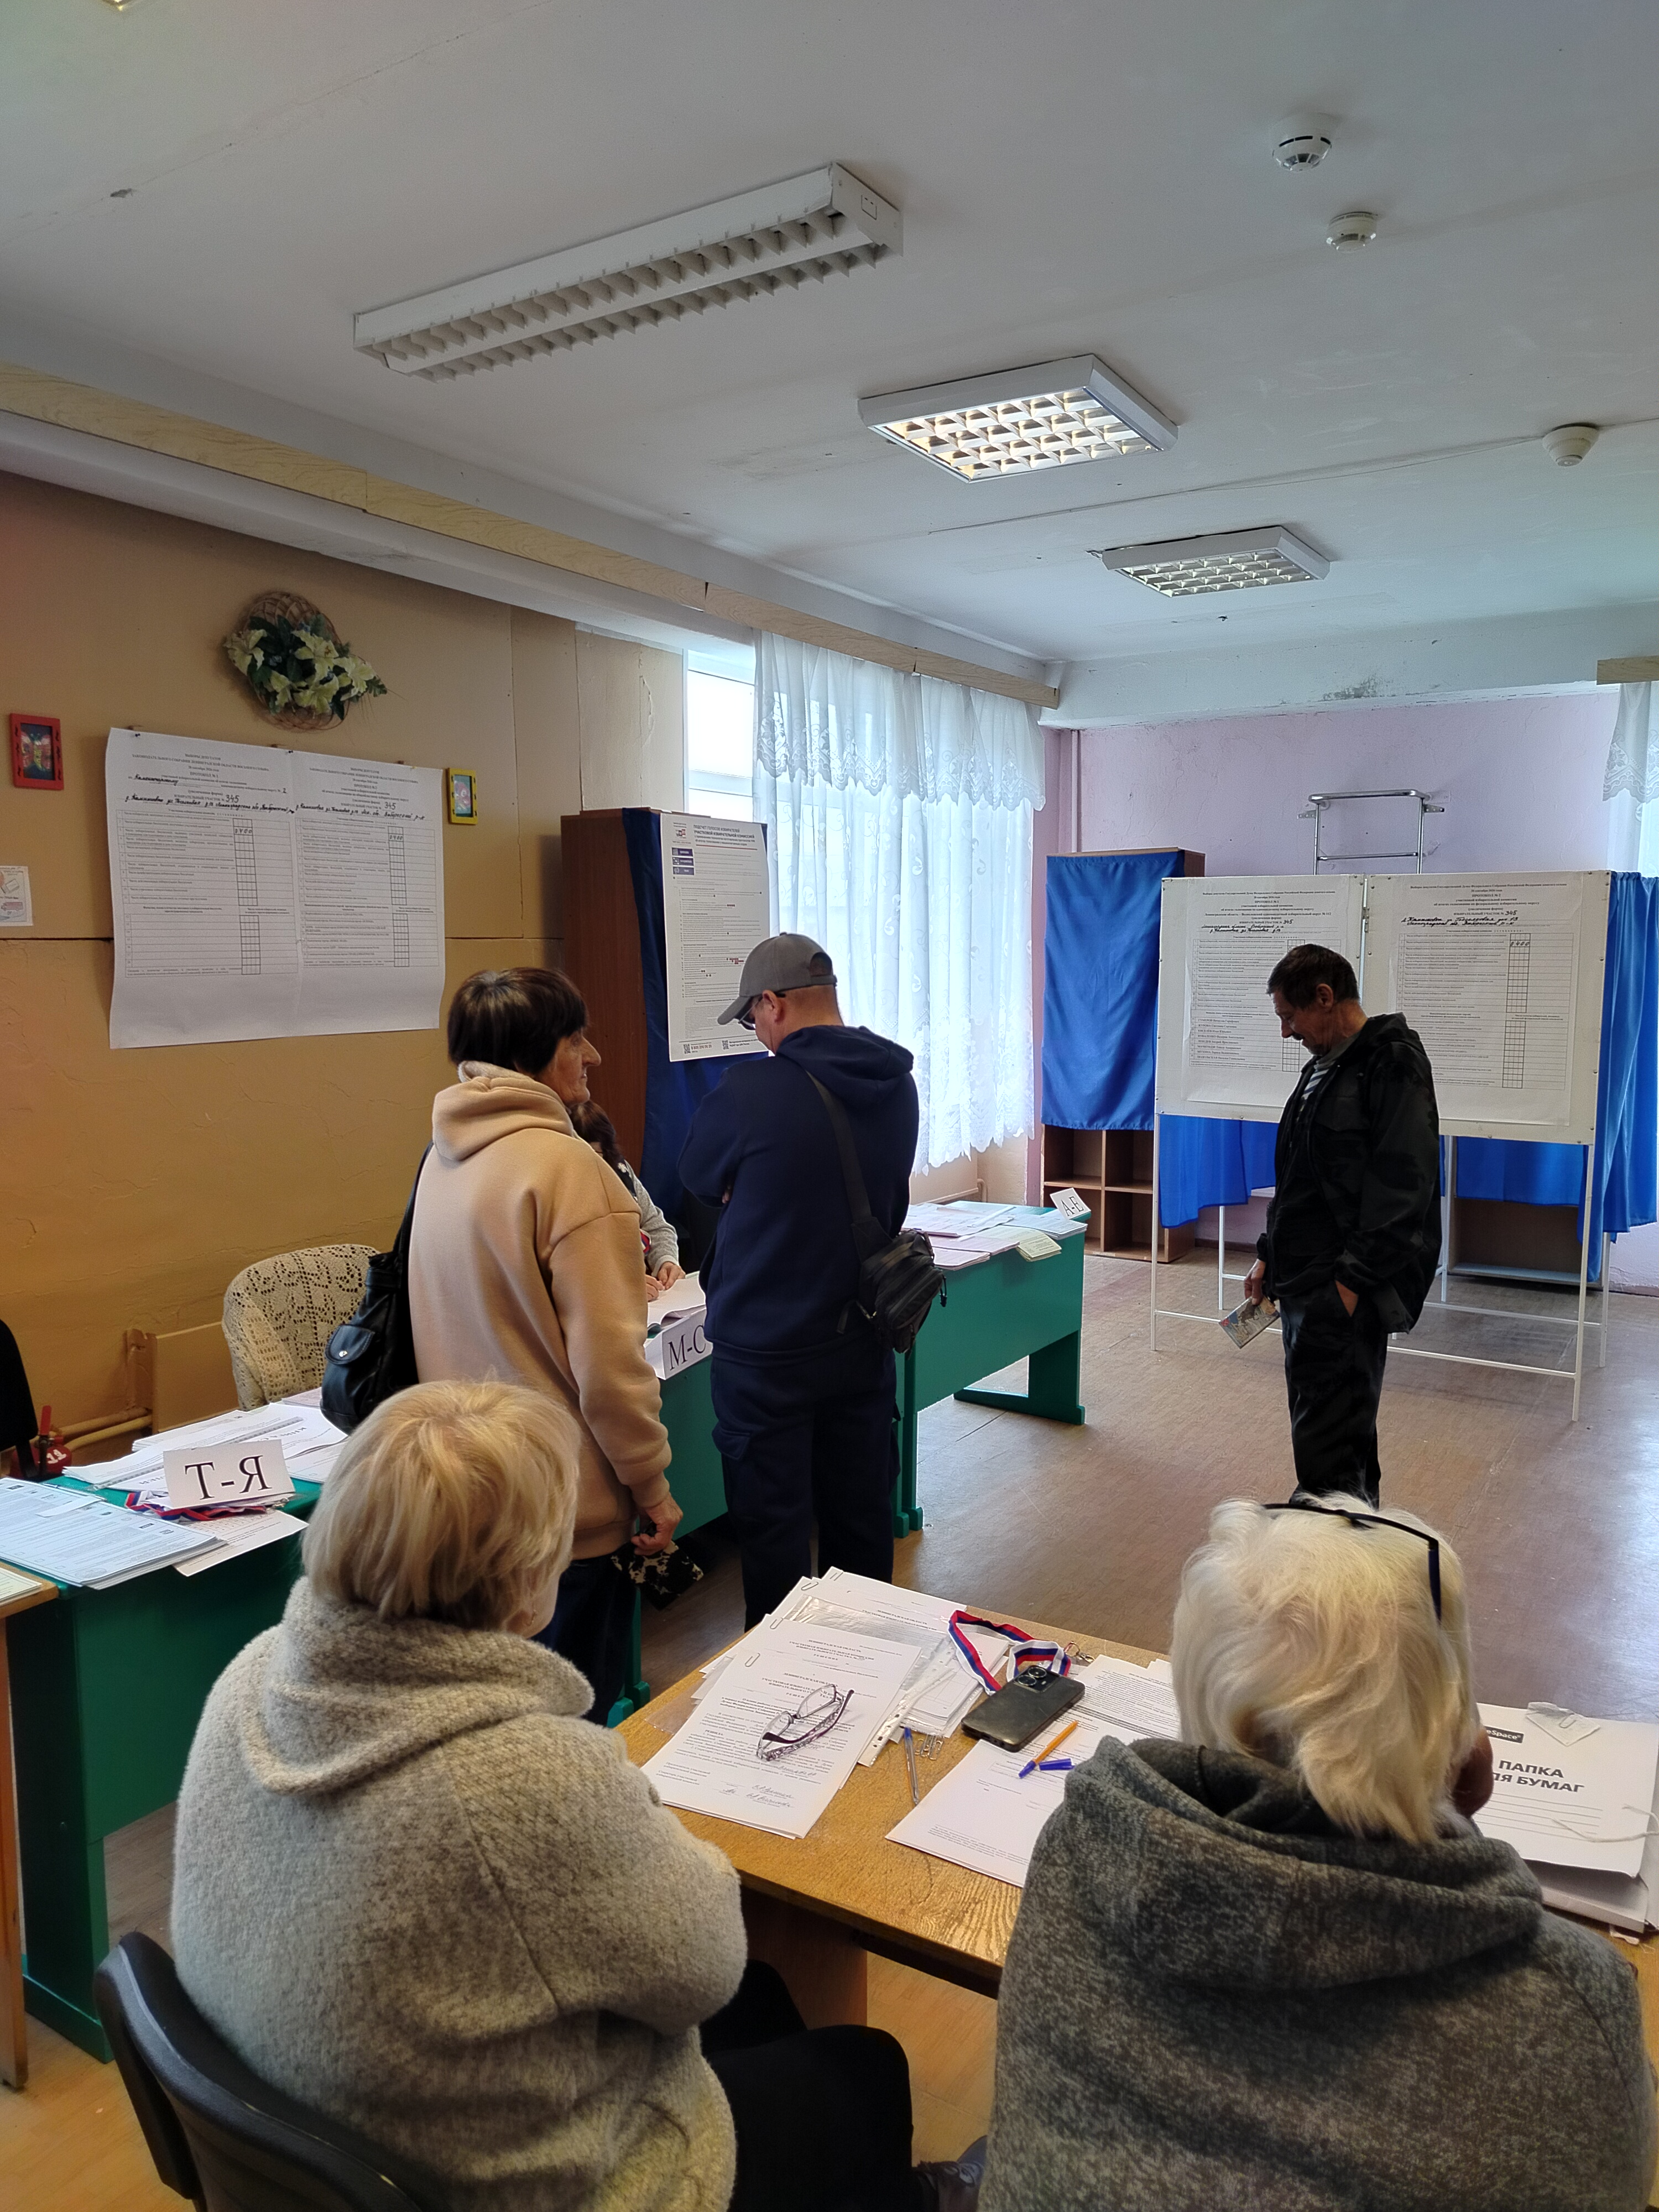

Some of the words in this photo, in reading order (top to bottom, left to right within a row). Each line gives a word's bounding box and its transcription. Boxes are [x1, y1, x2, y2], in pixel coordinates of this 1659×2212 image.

[226, 794, 240, 804] 345
[384, 801, 396, 810] 345
[667, 1324, 707, 1371] М-С
[184, 1454, 273, 1501] Т-Я
[1486, 1729, 1518, 1741] eSpace
[1498, 1760, 1564, 1778] ПАПКА
[1493, 1772, 1513, 1782] ЛЯ
[1516, 1776, 1585, 1792] БУМАГ
